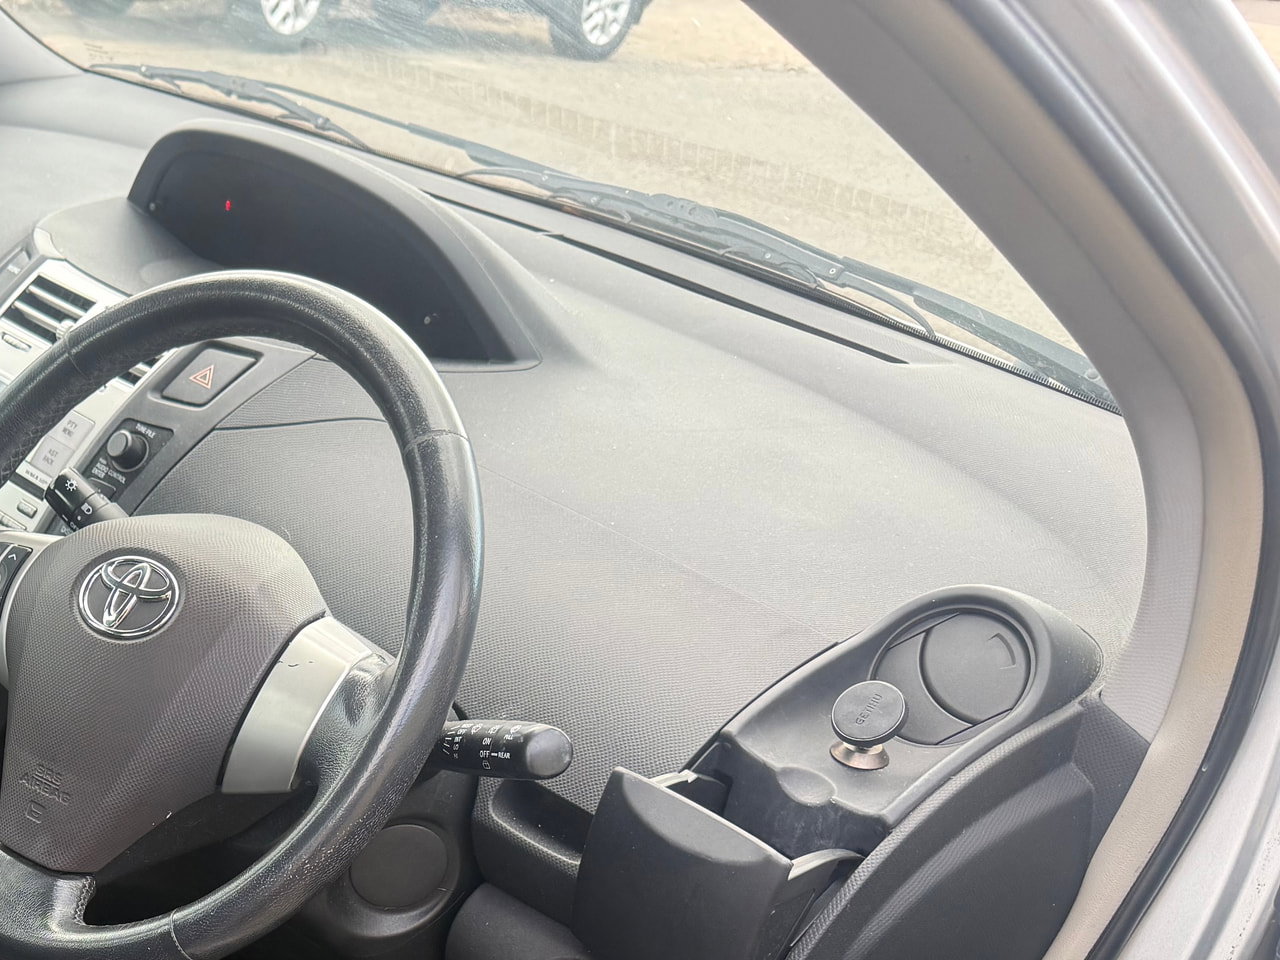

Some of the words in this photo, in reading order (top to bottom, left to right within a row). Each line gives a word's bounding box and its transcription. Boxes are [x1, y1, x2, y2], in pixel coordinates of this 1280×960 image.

[482, 738, 492, 746] ON
[479, 750, 490, 758] OFF
[497, 751, 511, 759] REAR
